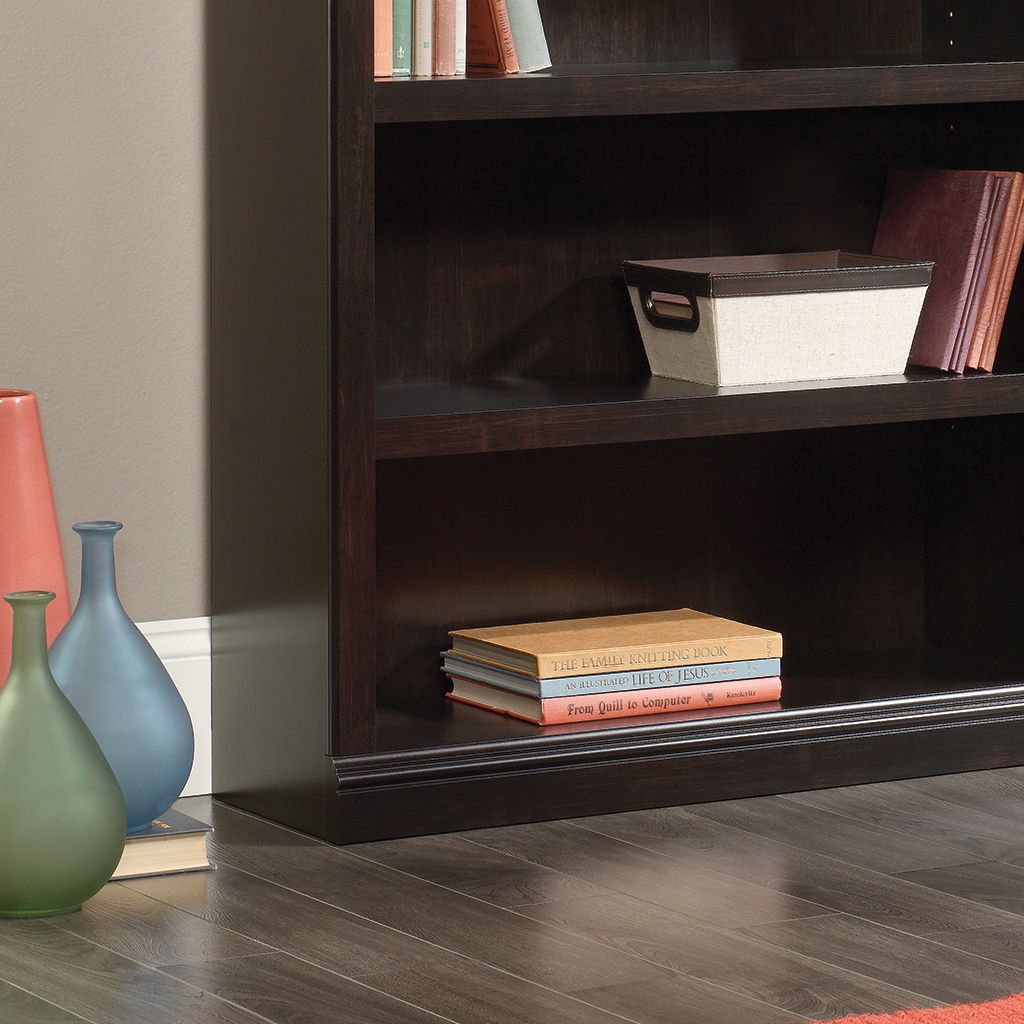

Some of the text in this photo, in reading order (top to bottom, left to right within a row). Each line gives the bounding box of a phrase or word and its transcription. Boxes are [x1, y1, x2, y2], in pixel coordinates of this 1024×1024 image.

[503, 34, 515, 59] YEAR
[551, 646, 728, 672] THE FAMILY KNITTING BOOK
[579, 676, 629, 689] ILLUSTRATED
[632, 673, 655, 685] LIFE
[658, 671, 673, 683] OF
[675, 667, 709, 684] JESUS
[567, 703, 594, 715] From
[598, 699, 623, 715] Quill
[627, 700, 638, 710] to
[642, 695, 692, 710] Computer
